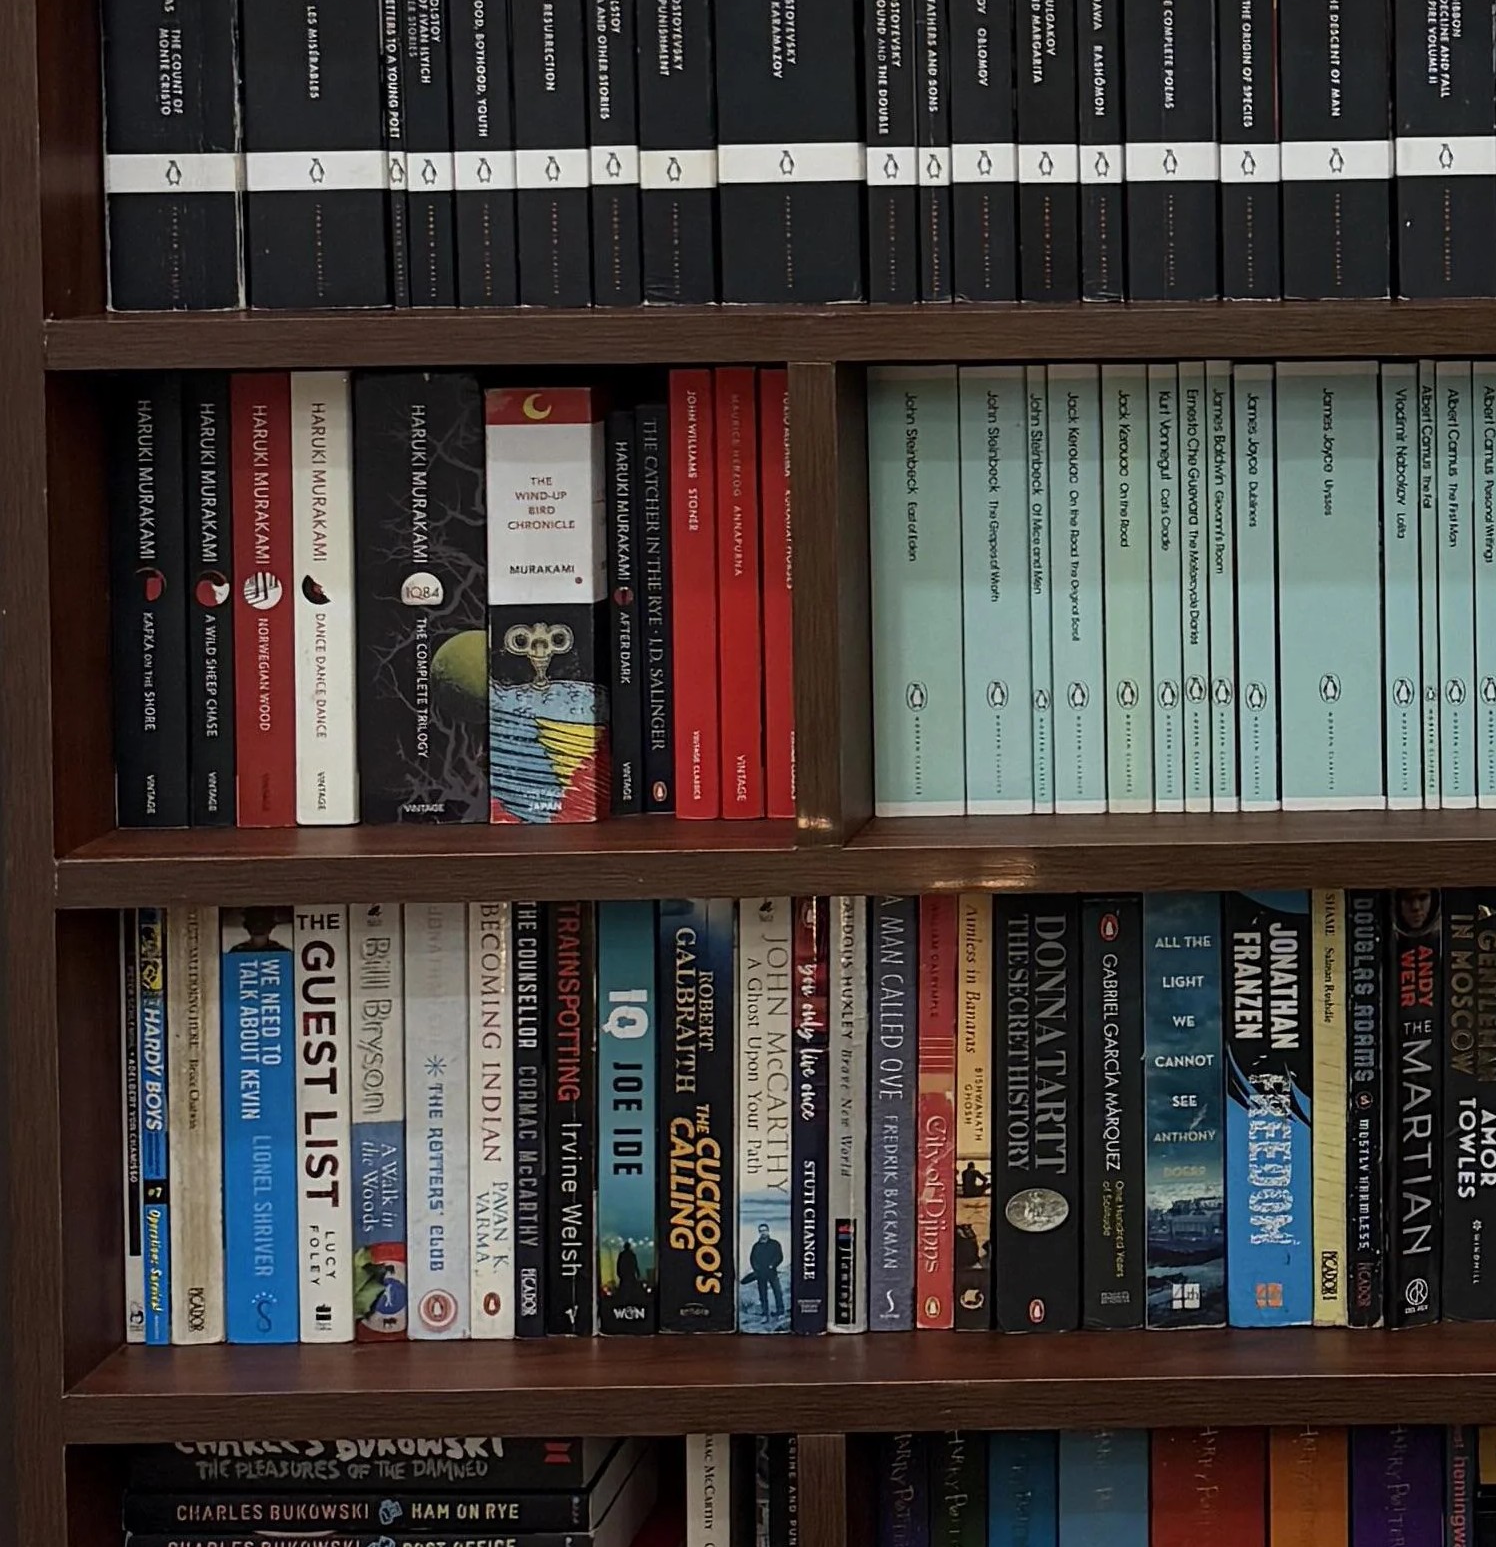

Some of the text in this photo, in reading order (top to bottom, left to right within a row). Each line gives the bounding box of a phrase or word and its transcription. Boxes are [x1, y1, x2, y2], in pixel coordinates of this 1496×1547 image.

[530, 476, 552, 485] THE
[515, 490, 567, 500] WIND-UP
[529, 506, 555, 515] BIRD
[508, 520, 575, 530] CHRONICLE
[510, 564, 575, 574] MURAKAMI
[296, 915, 340, 931] THE
[1155, 935, 1212, 947] ALL THE
[1162, 976, 1204, 988] LIGHT
[1173, 1016, 1195, 1027] WE
[1155, 1055, 1214, 1067] CANNOT
[301, 940, 339, 1207] GUEST LIST
[1172, 1096, 1197, 1107] SEE
[1154, 1131, 1215, 1143] ANTHONY
[670, 1118, 693, 1249] CALLING
[694, 1139, 721, 1295] CUCKOO'S
[309, 1225, 320, 1286] FOLEY
[324, 1231, 335, 1279] LUCY
